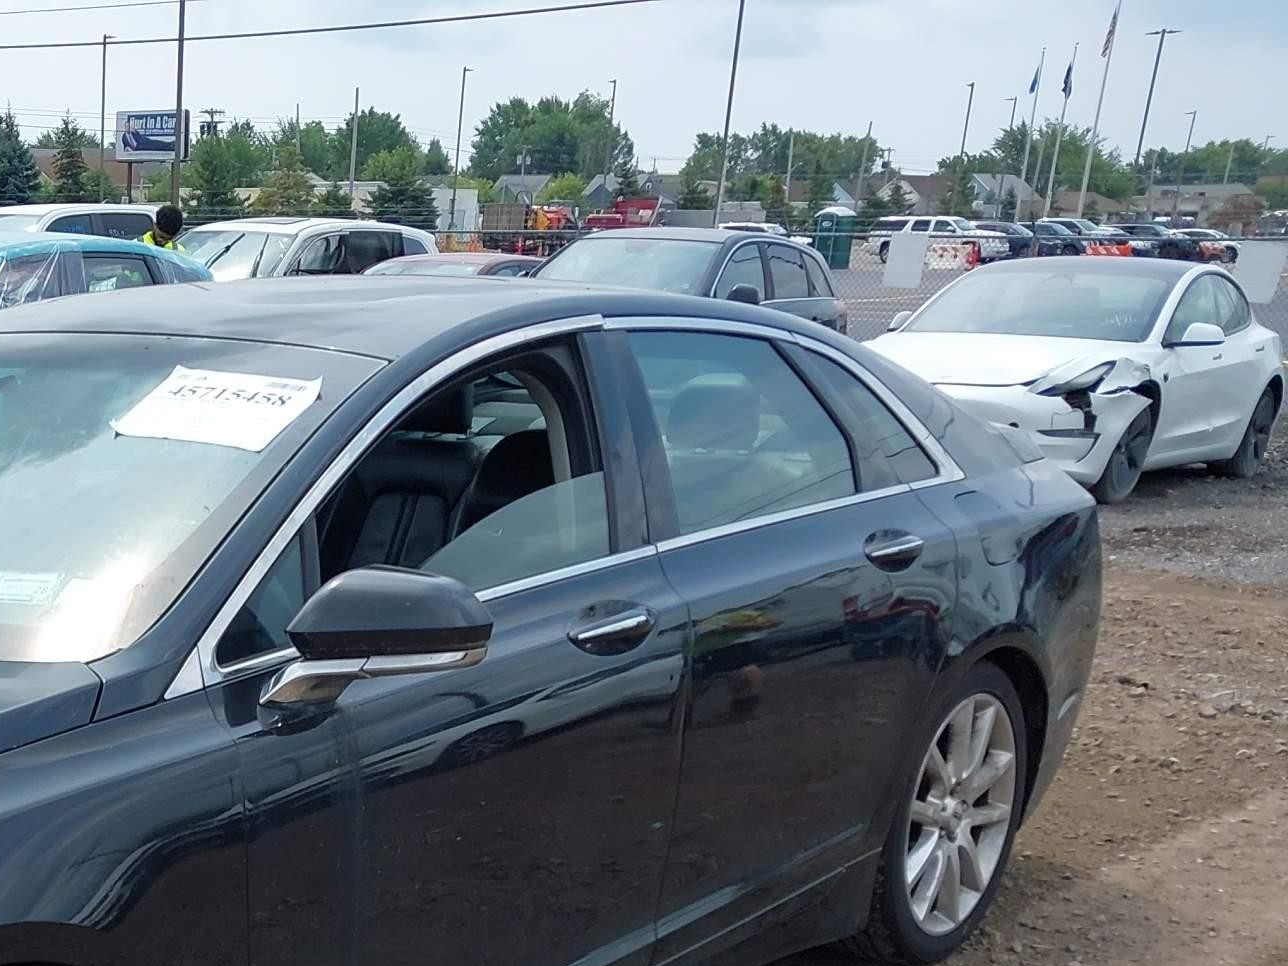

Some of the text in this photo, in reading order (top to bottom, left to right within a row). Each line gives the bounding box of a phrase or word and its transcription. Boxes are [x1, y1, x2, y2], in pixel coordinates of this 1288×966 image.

[129, 116, 146, 129] Hurt
[147, 116, 155, 129] In
[155, 115, 162, 129] A
[168, 384, 293, 407] 45715458
